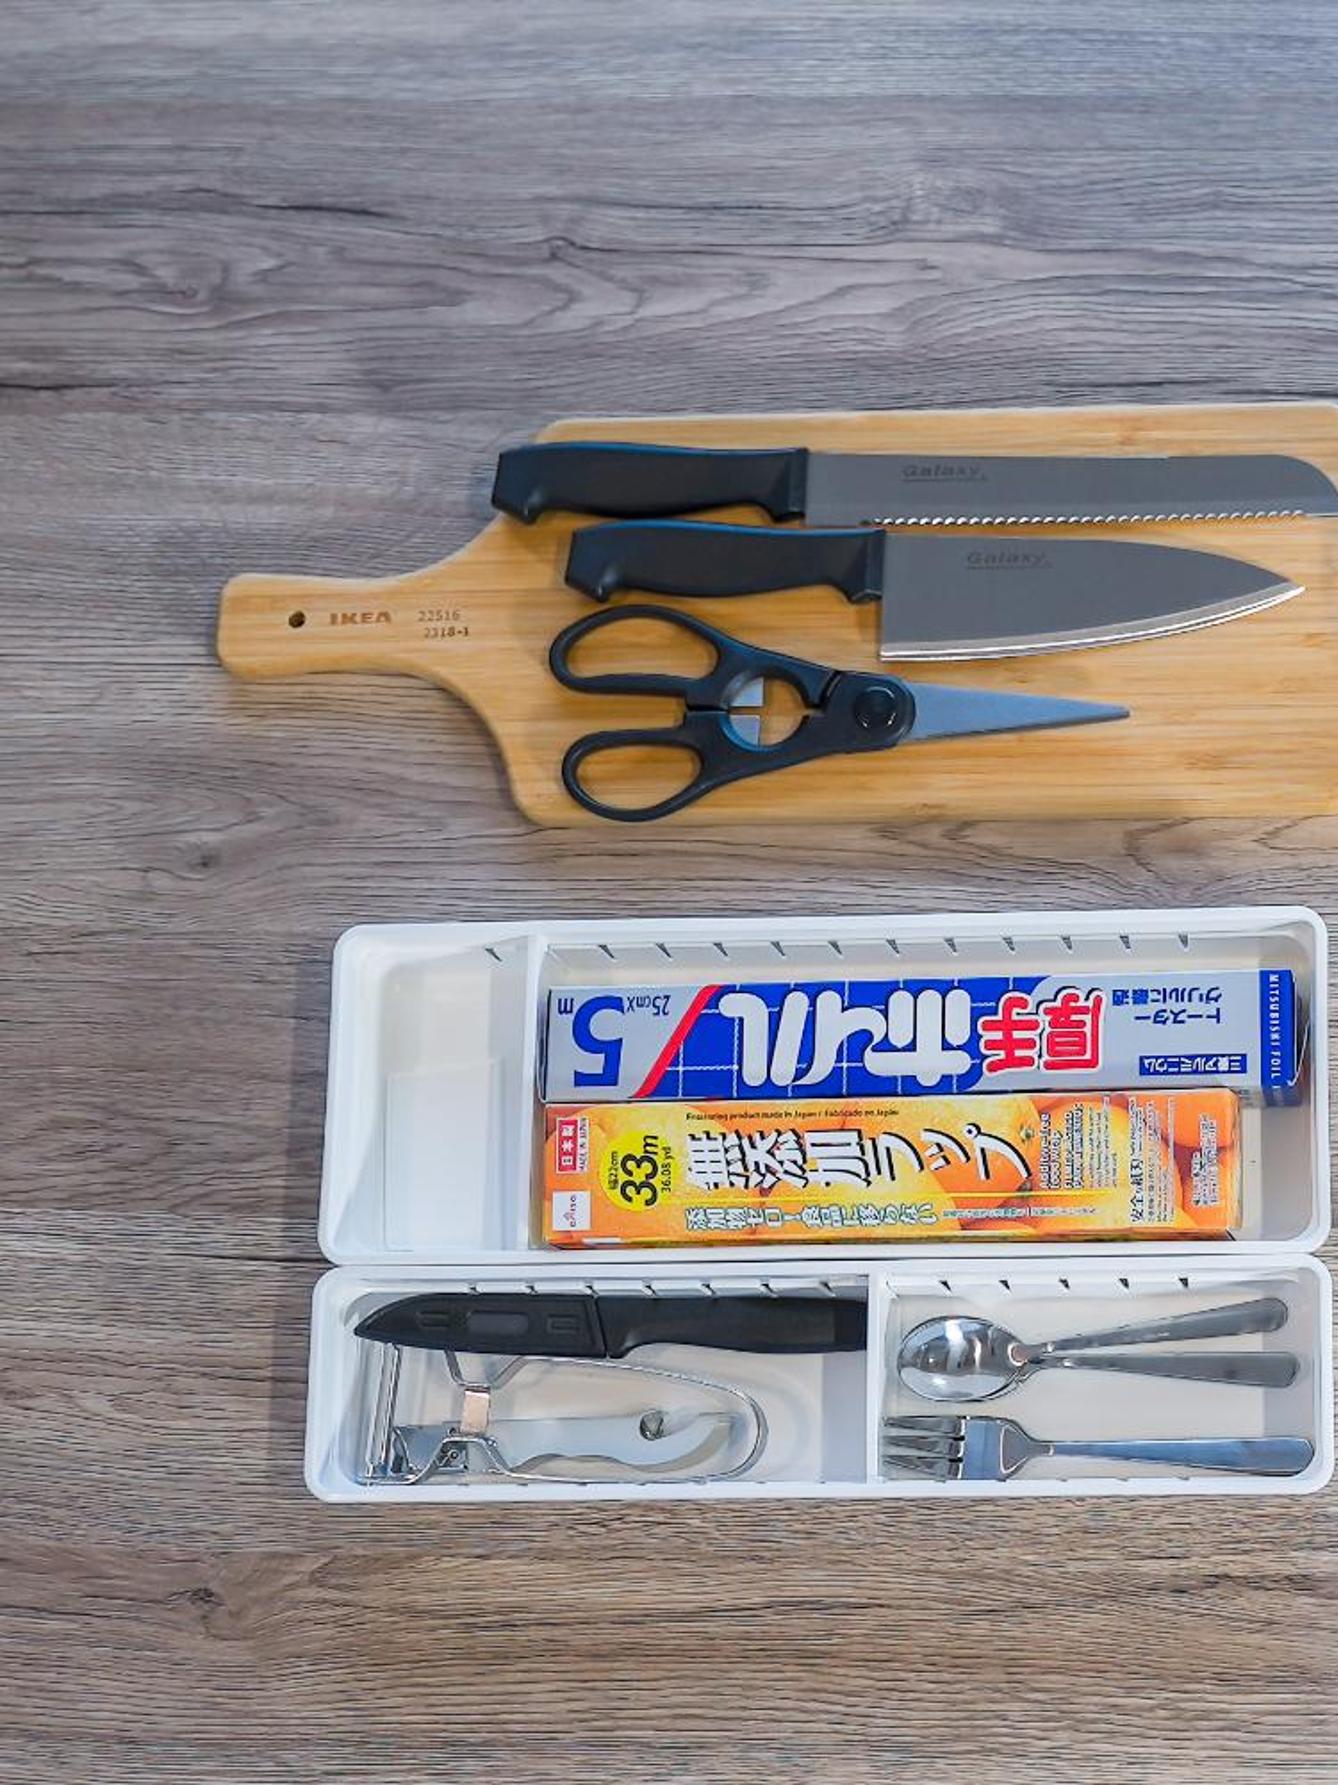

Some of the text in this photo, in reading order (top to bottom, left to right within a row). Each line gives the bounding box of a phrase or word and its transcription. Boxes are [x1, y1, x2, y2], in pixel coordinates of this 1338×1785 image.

[902, 463, 981, 478] Galaxy
[966, 550, 1047, 566] Galaxy
[329, 611, 393, 626] IKEA
[418, 608, 461, 622] 22516
[1111, 987, 1223, 1007] グリルに最適
[1134, 1007, 1221, 1026] トースター
[1268, 973, 1281, 1046] MITSUBISHI
[1270, 1051, 1281, 1079] FOIL
[561, 1124, 575, 1166] 日本製
[662, 1146, 675, 1160] yd
[687, 1123, 1033, 1189] 無添加ラップ
[620, 1135, 659, 1207] 33m
